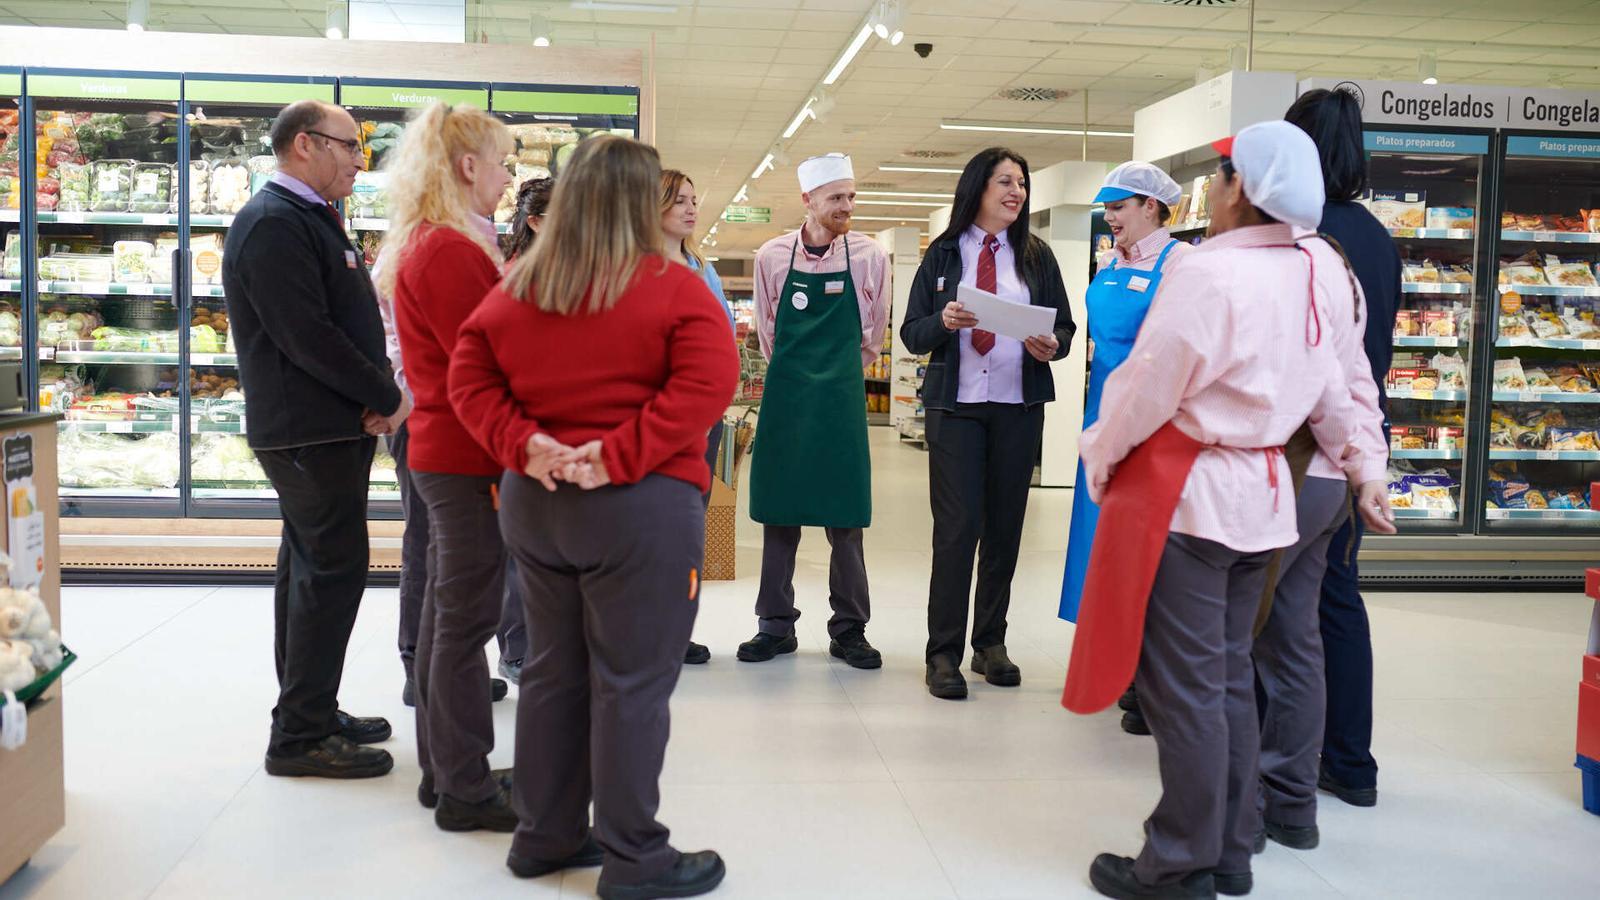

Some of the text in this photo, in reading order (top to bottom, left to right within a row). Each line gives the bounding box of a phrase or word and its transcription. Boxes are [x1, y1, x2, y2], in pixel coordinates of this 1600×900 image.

[1381, 90, 1494, 120] Congelados
[1523, 96, 1599, 126] Congela
[1376, 136, 1456, 149] Platos preparados
[1540, 141, 1566, 151] Platos
